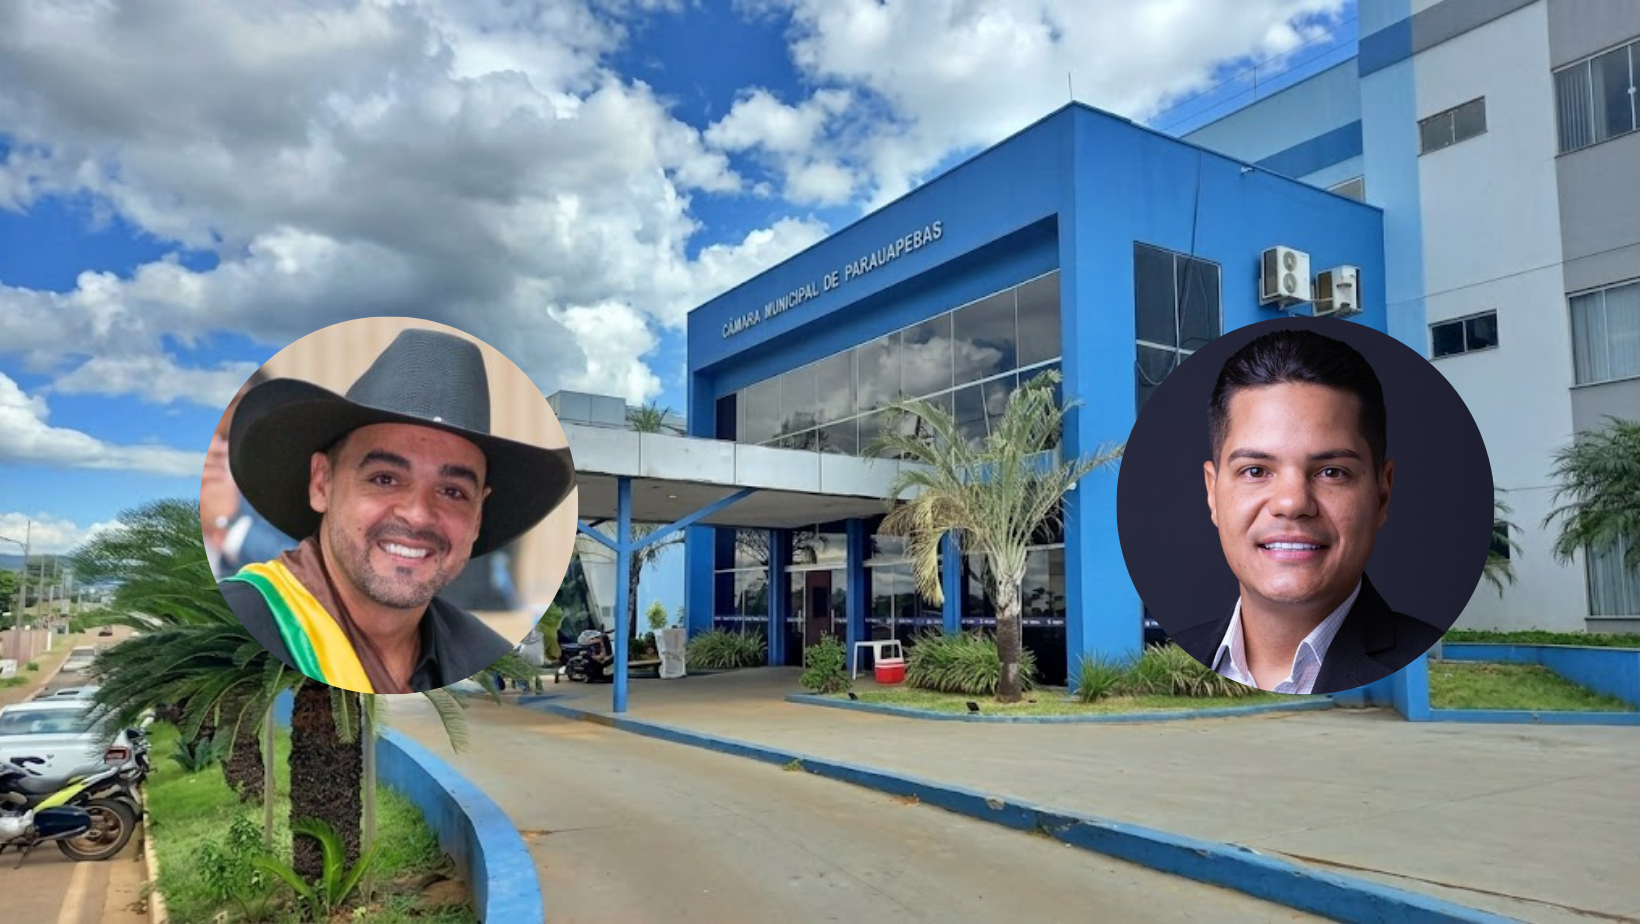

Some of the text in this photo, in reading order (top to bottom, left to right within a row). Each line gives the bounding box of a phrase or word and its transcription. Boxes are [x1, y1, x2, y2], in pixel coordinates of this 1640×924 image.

[722, 220, 942, 338] CÂMARA MUNICIPAL DE PARAUAPEBAS
